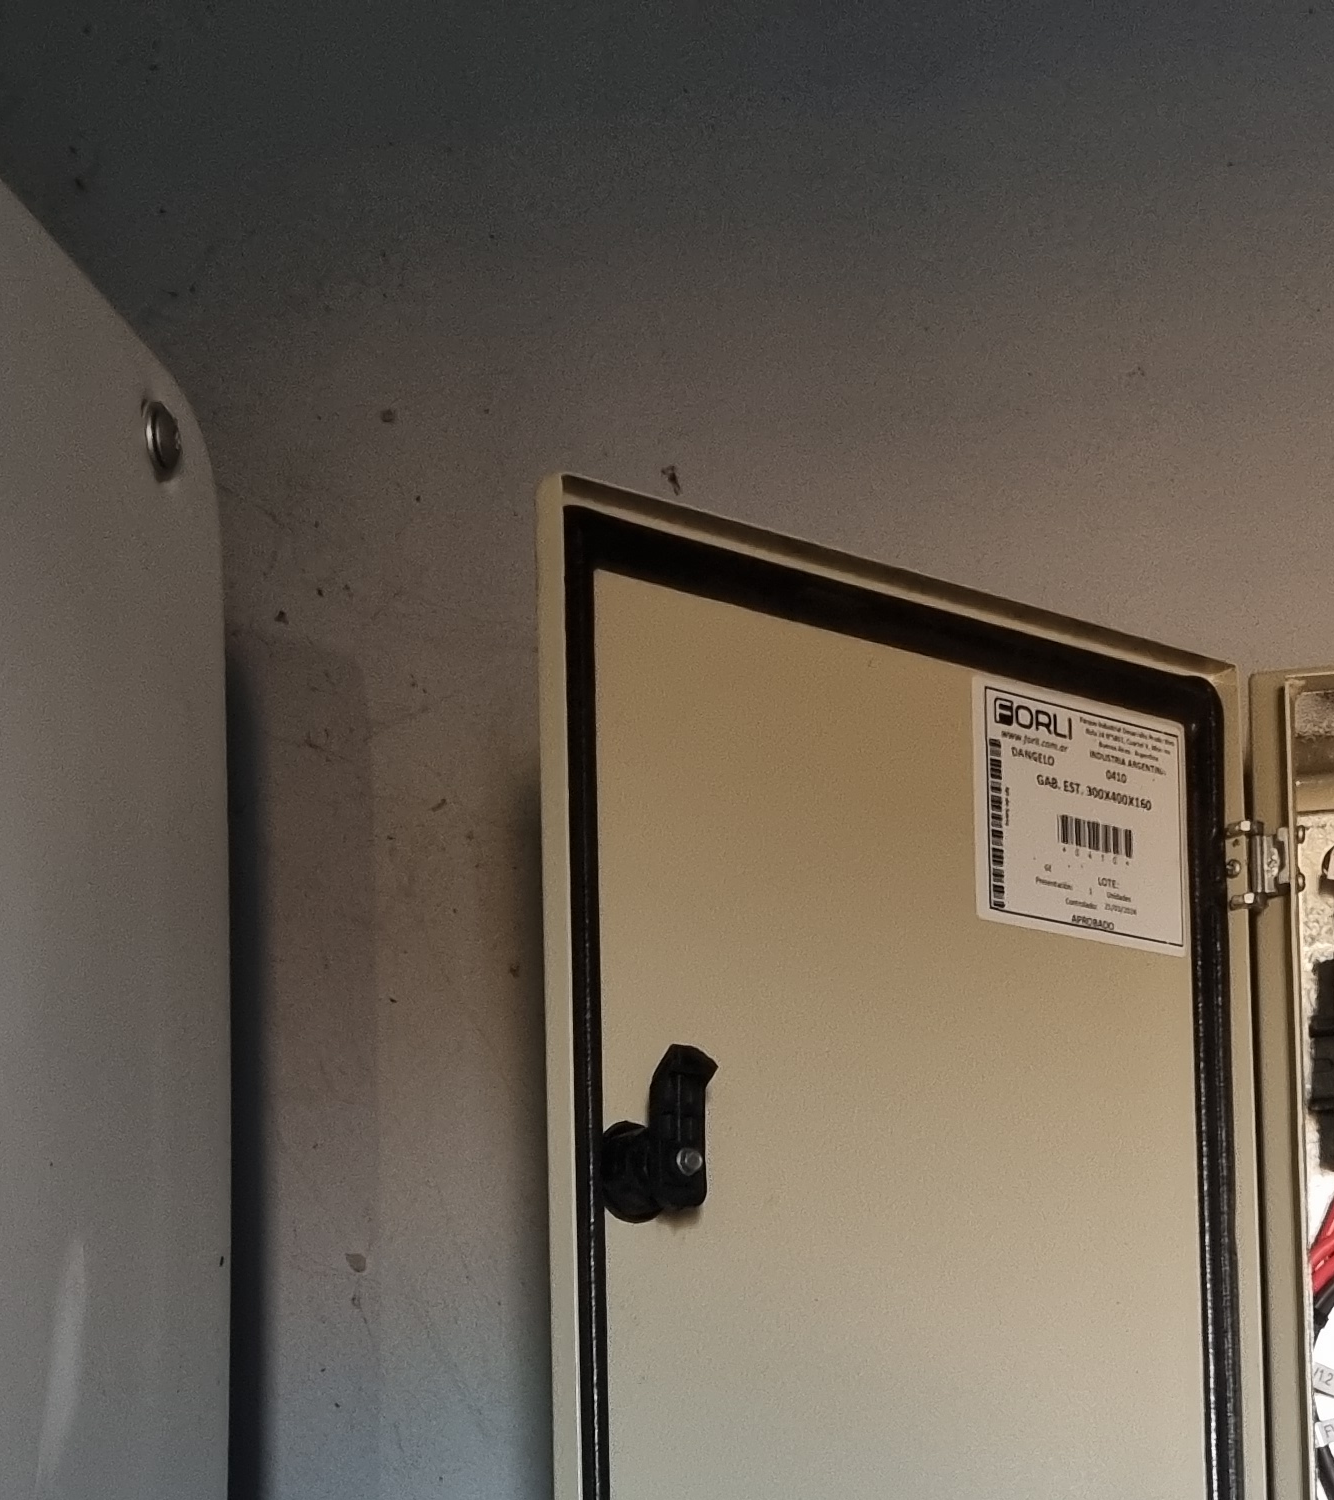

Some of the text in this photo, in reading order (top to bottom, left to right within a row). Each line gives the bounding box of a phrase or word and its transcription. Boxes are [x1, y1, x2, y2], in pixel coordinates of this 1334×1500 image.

[994, 696, 1072, 740] FORLI
[1089, 751, 1126, 766] INDUSTRIA
[1036, 774, 1061, 790] GAB.
[1071, 914, 1115, 931] APROBADO
